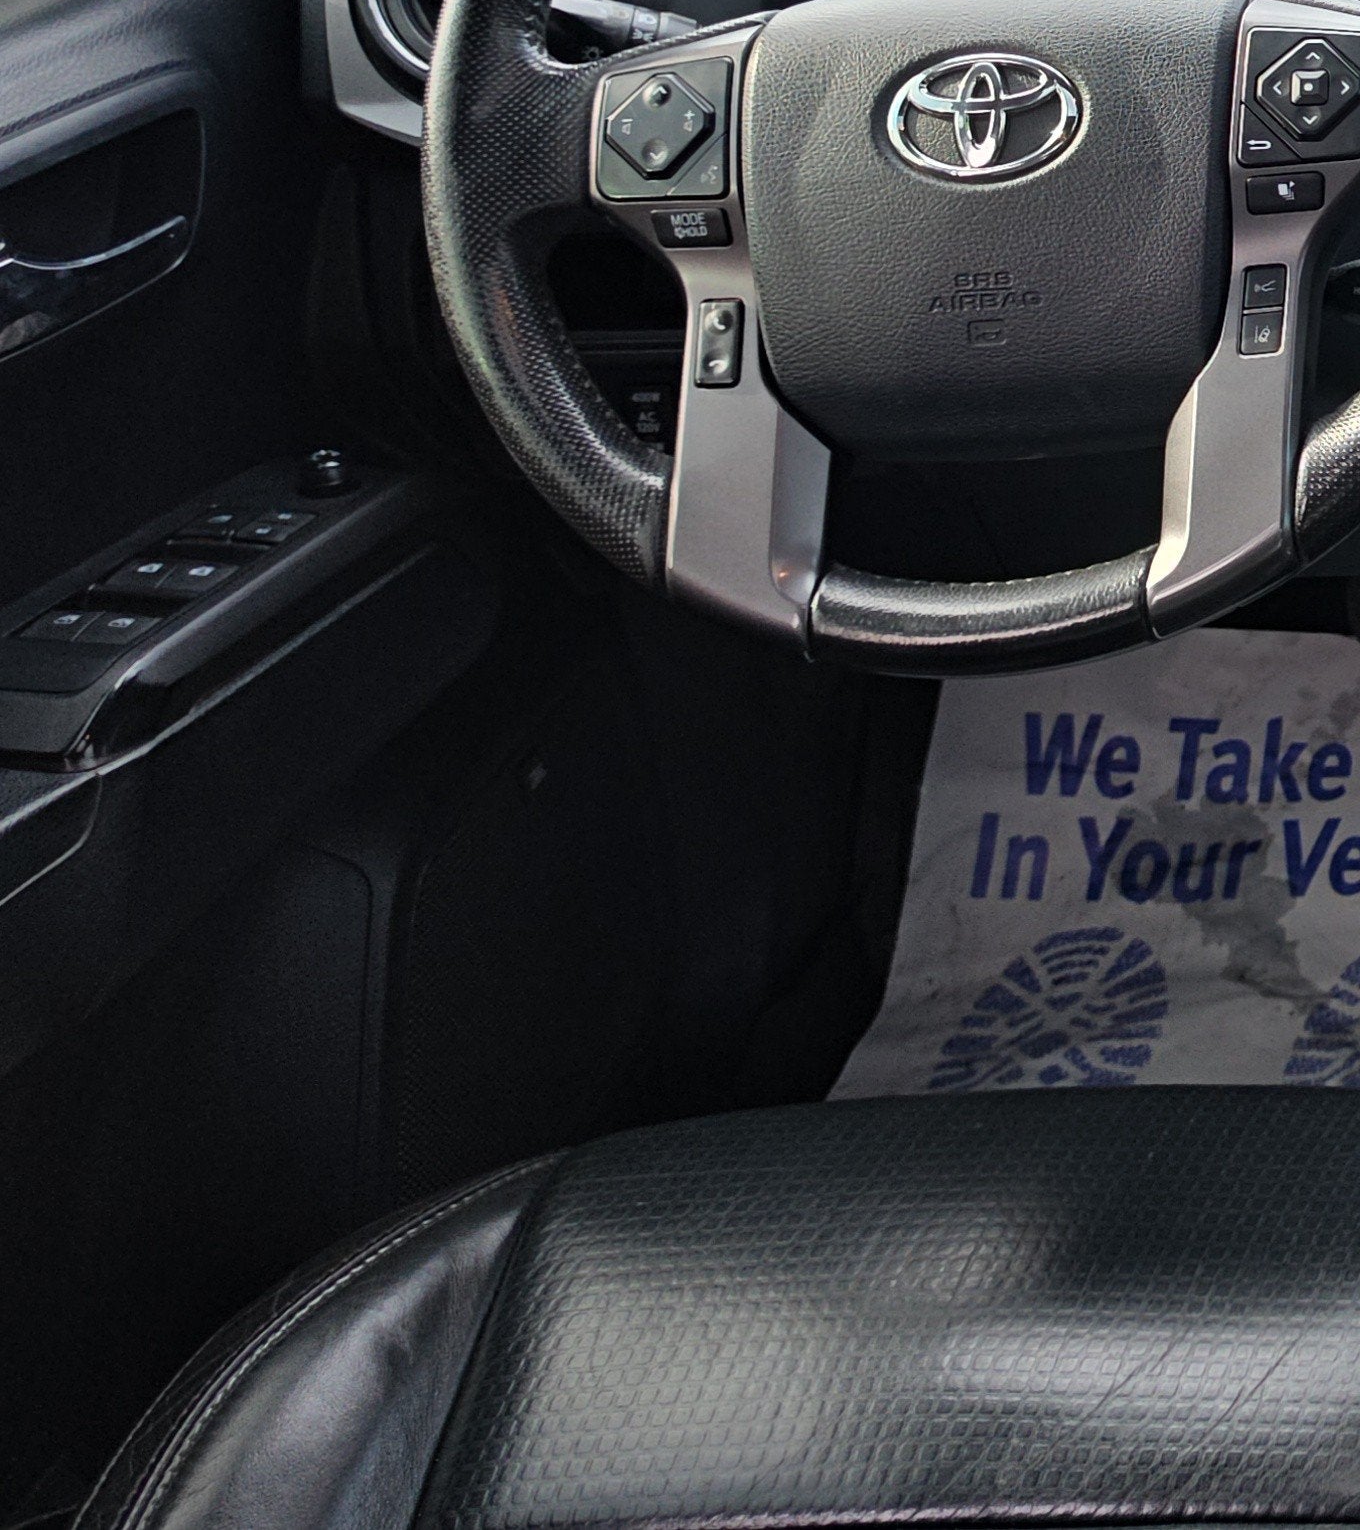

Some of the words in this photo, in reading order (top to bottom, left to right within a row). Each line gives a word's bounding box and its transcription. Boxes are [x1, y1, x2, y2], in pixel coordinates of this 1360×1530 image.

[670, 212, 707, 227] MODE
[953, 271, 1015, 288] SRS
[928, 290, 1046, 313] AIRBAG
[1023, 712, 1141, 800] We
[1167, 715, 1352, 804] Take
[969, 812, 1050, 901] In
[1077, 815, 1263, 905] Your
